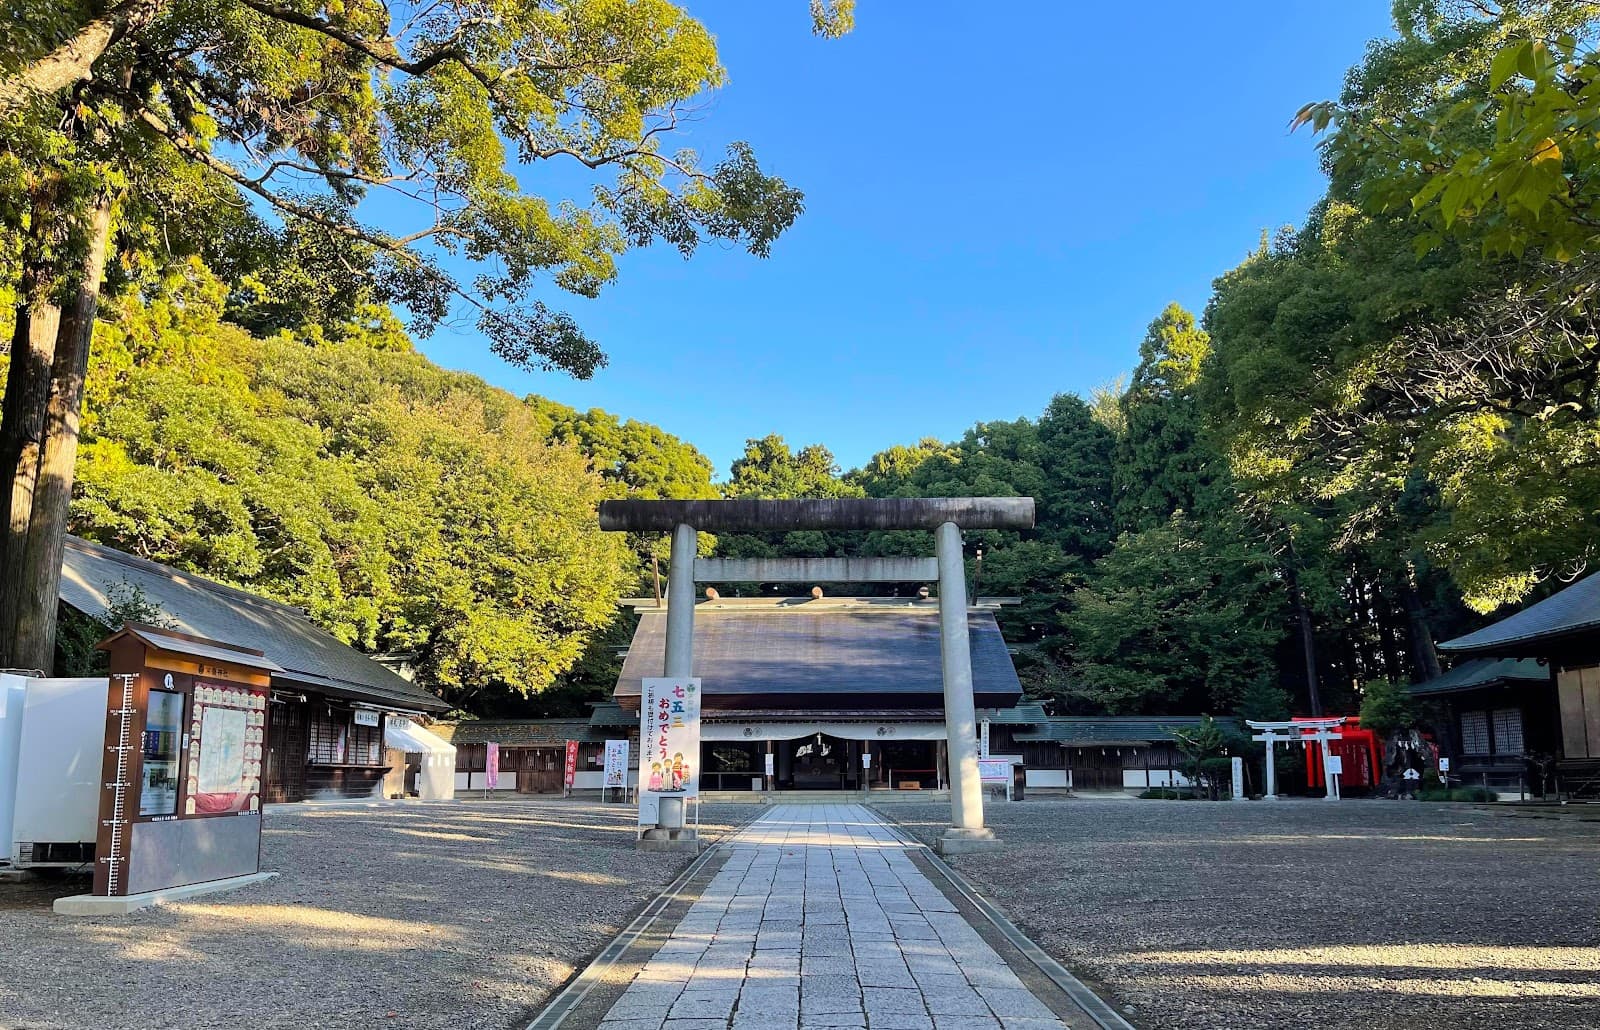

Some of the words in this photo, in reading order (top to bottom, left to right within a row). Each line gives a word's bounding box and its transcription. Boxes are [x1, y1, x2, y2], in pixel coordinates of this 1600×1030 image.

[659, 697, 670, 760] おめでとう
[671, 685, 685, 728] 七五三
